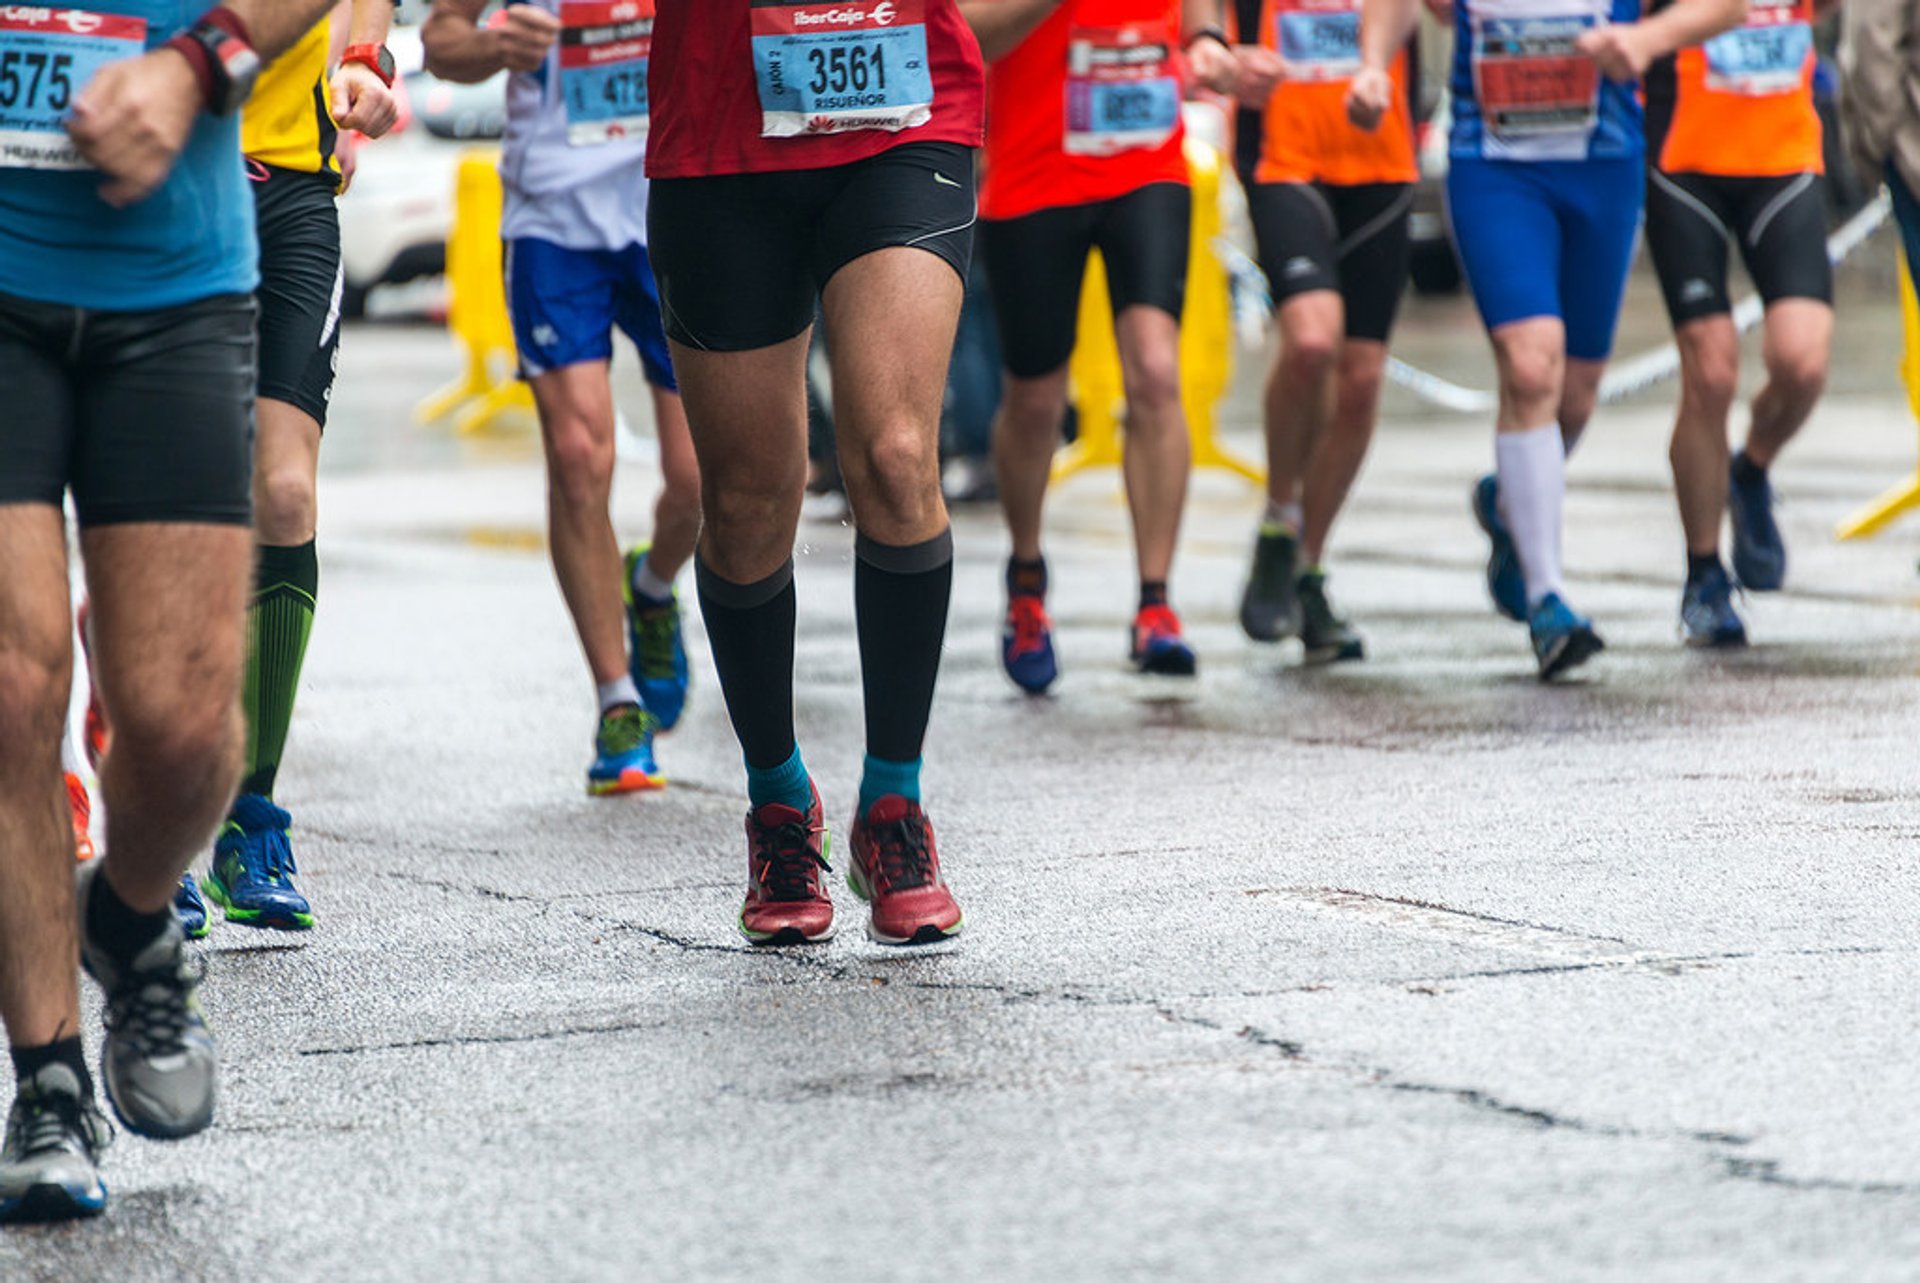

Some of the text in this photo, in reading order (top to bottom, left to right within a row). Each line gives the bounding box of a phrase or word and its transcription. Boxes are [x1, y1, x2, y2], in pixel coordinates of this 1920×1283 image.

[0, 52, 73, 110] 575
[808, 44, 884, 94] 3561
[815, 92, 886, 109] RISUEÑOR
[840, 117, 900, 127] HUAWEI
